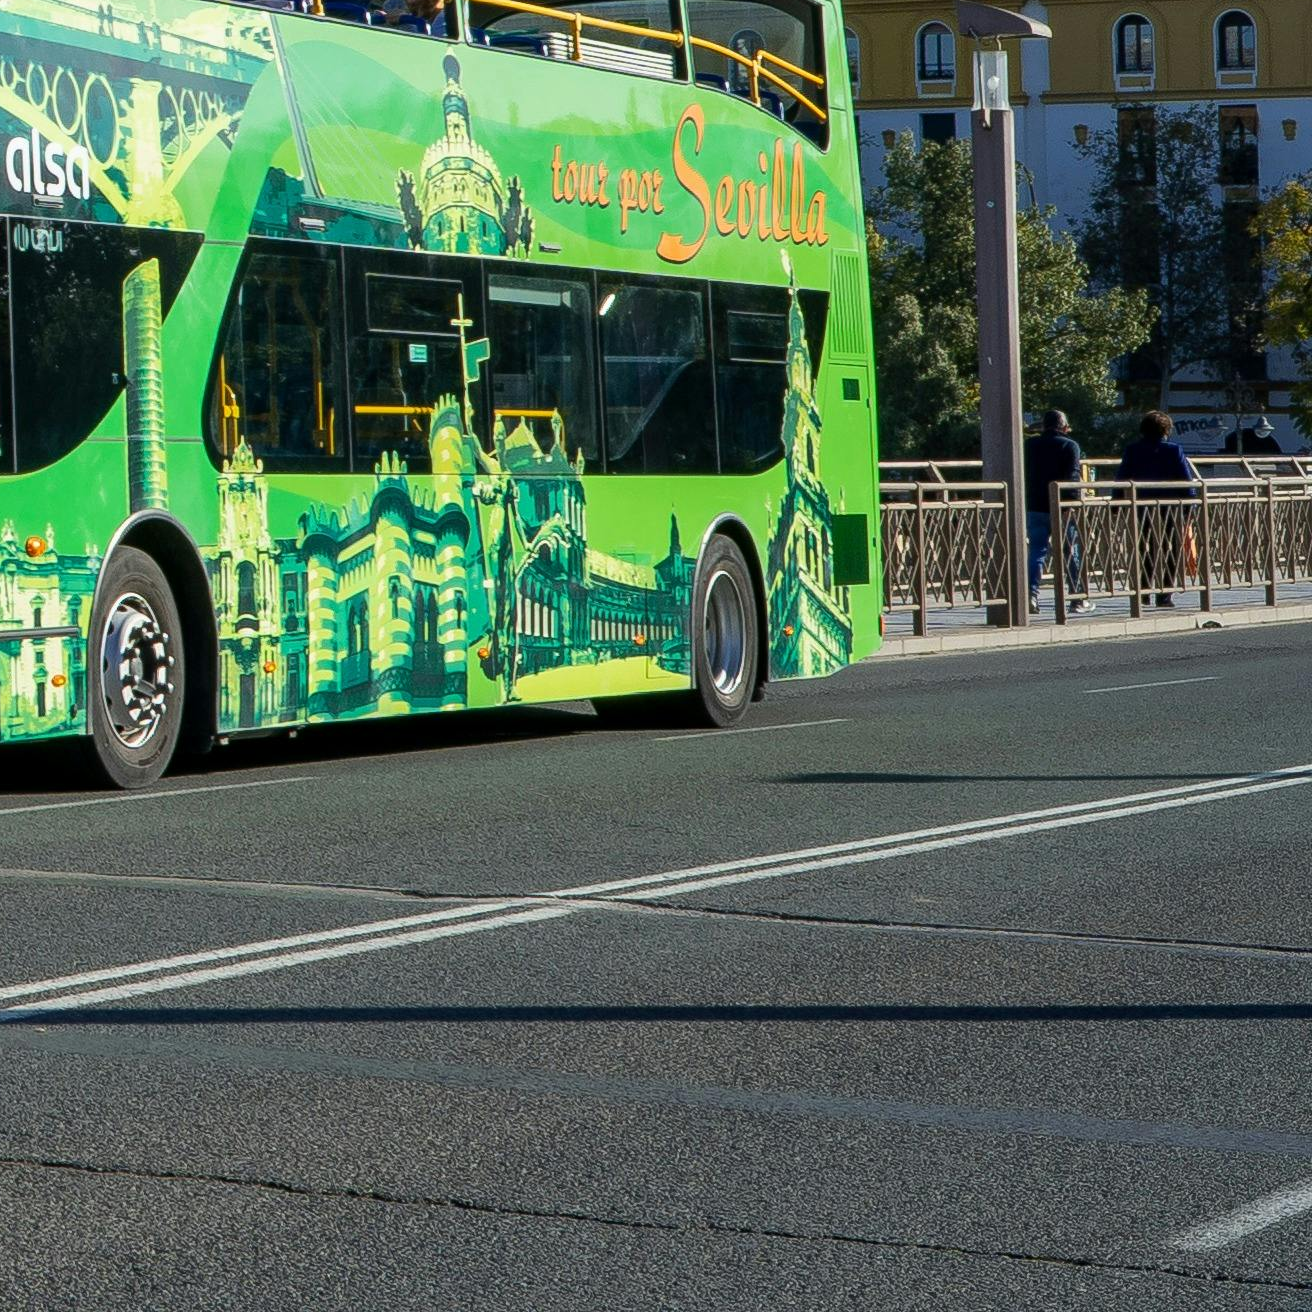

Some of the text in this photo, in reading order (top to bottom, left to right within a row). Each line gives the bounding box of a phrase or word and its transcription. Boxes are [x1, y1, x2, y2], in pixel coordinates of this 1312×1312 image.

[5, 127, 90, 220] alsa
[551, 103, 829, 264] tour por Sevilla
